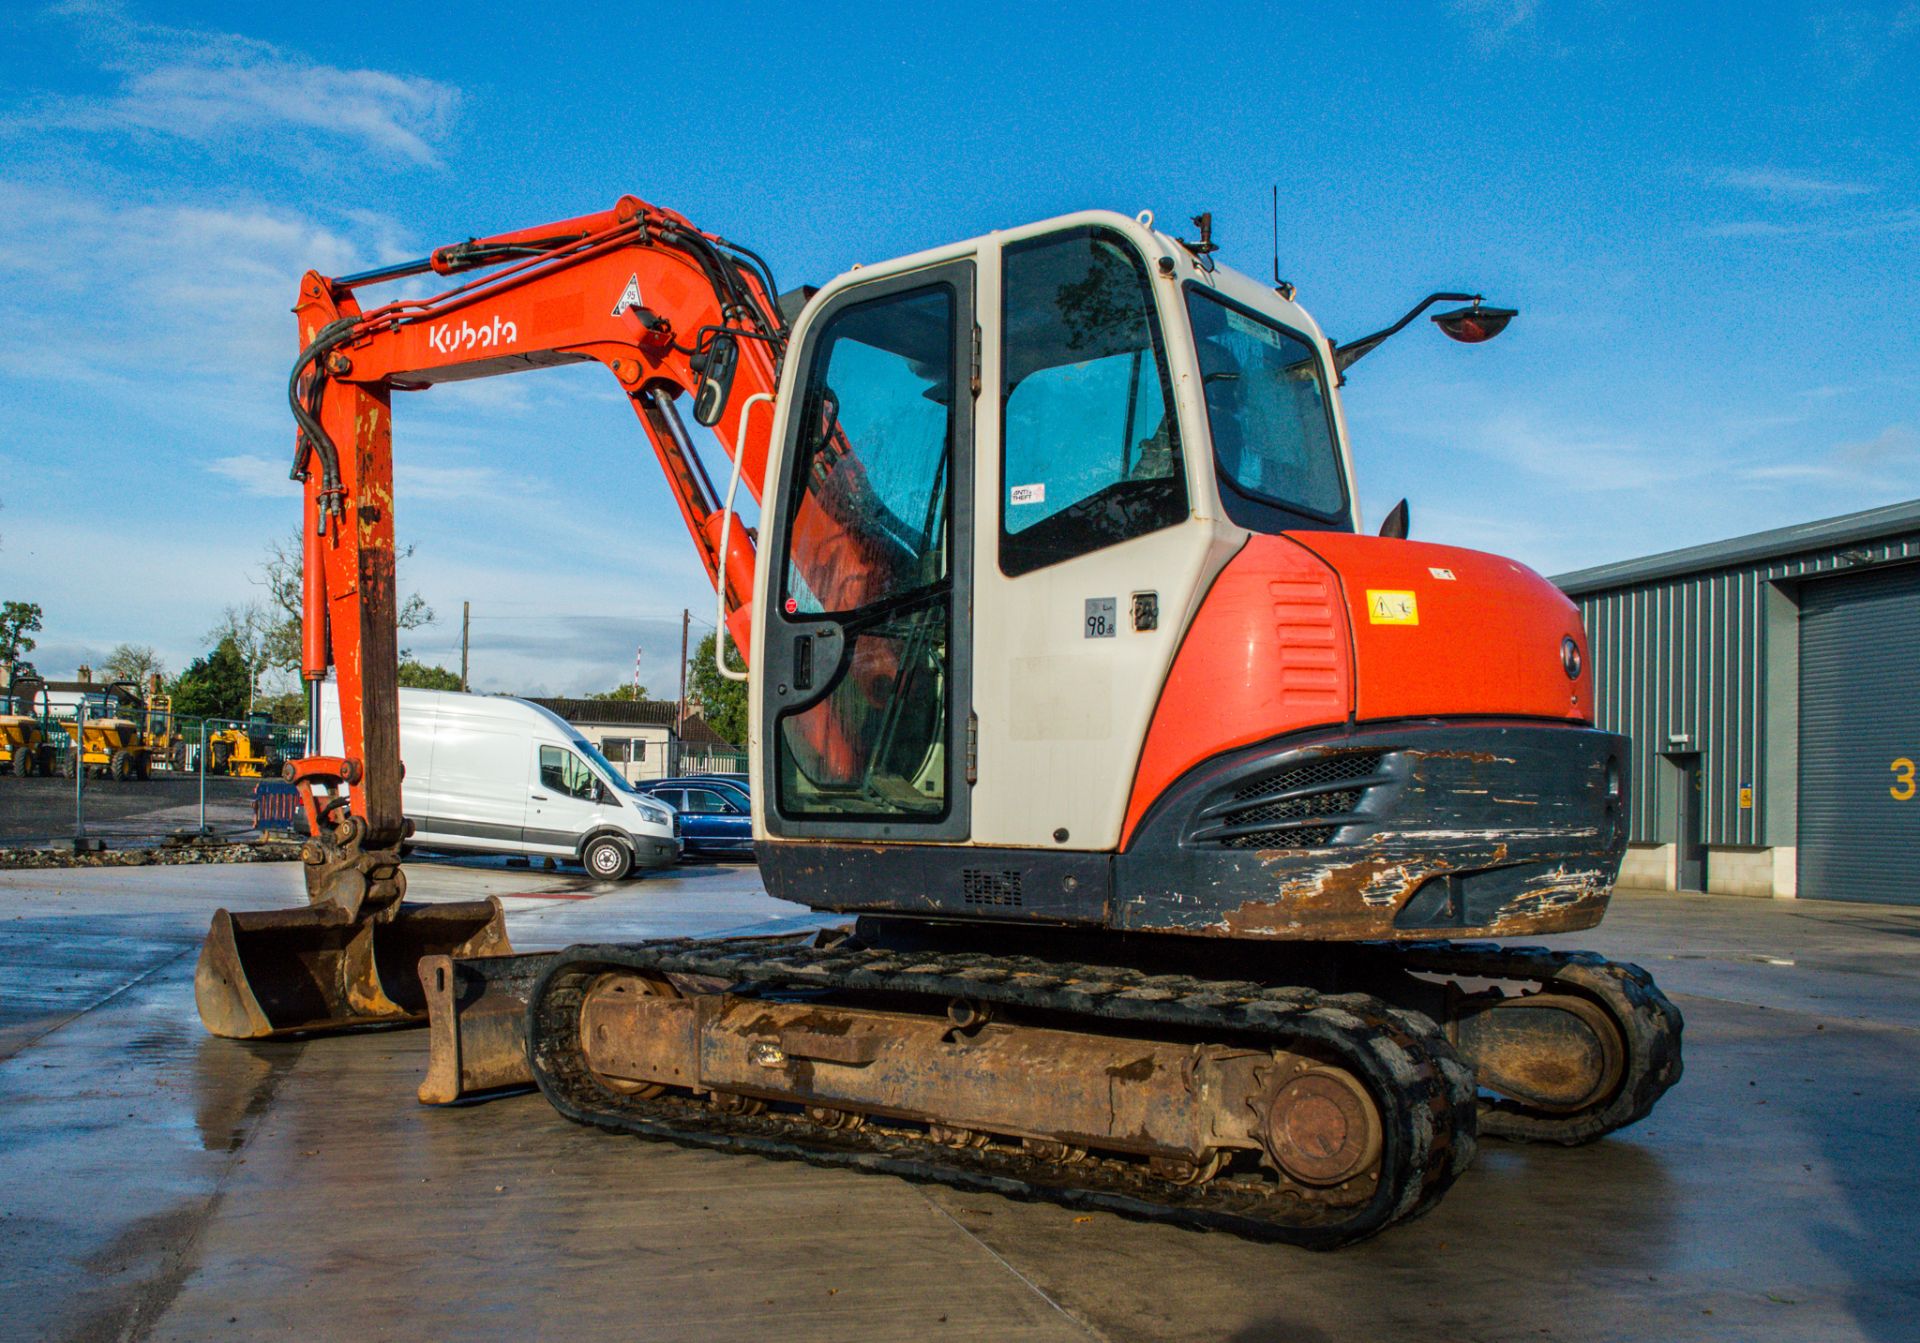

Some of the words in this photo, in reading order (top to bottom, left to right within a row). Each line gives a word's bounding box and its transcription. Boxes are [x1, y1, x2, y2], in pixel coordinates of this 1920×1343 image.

[429, 315, 517, 353] Kubota
[1087, 615, 1105, 636] 98
[1890, 757, 1916, 801] 3
